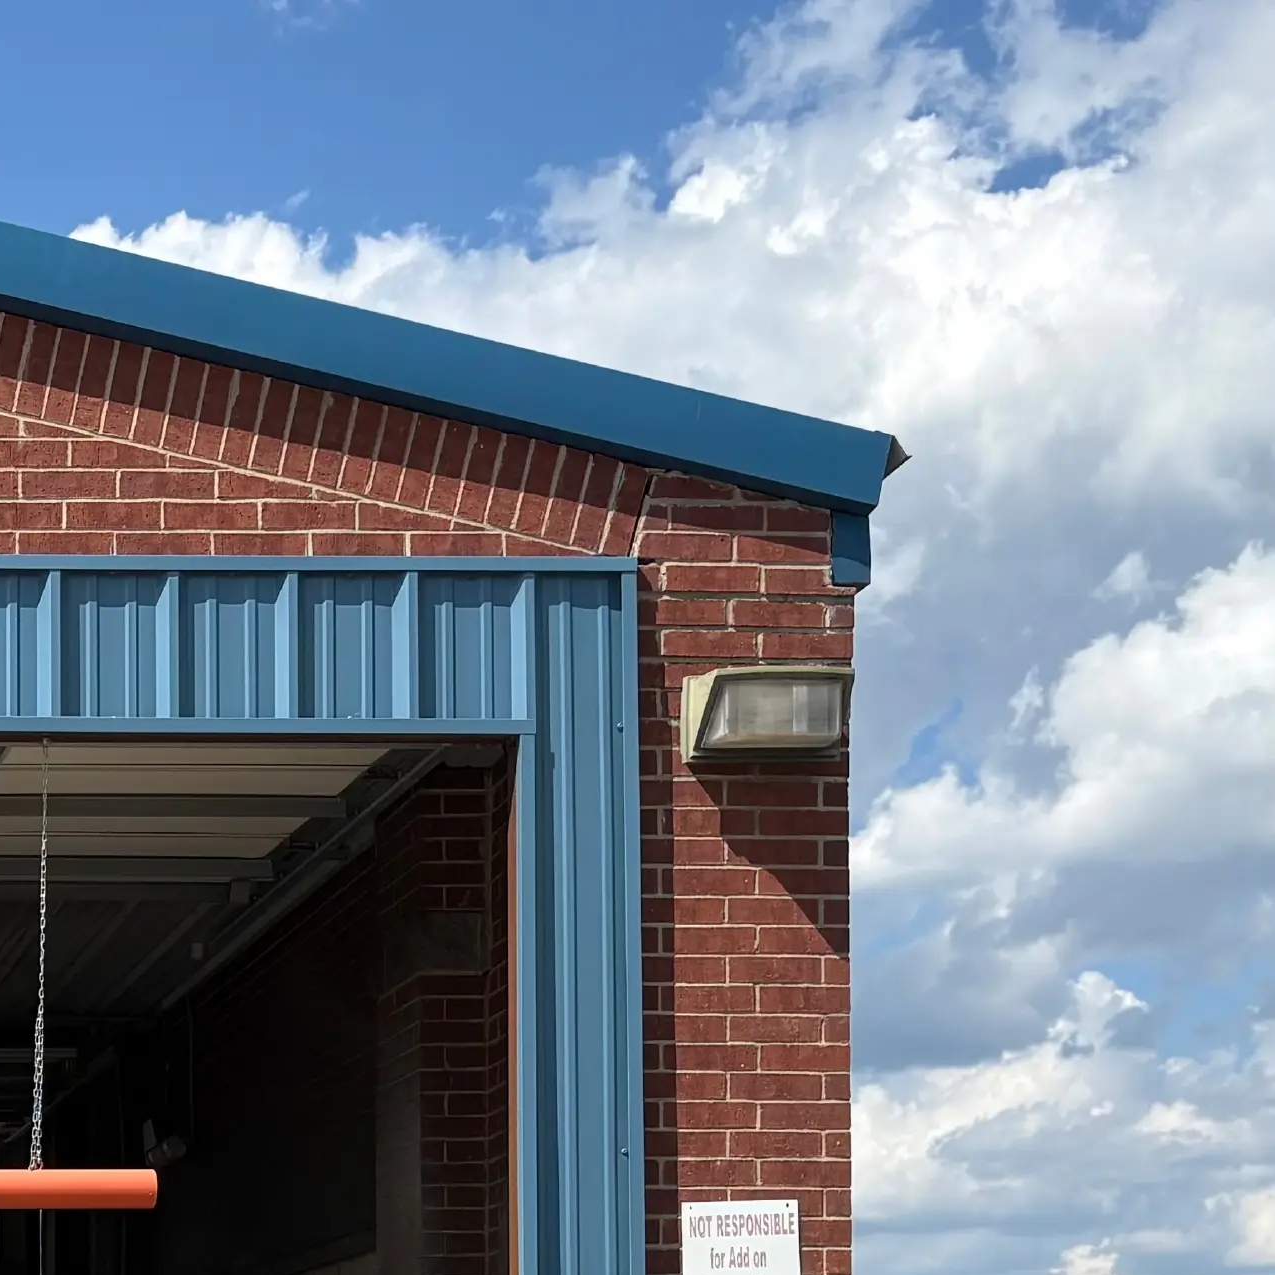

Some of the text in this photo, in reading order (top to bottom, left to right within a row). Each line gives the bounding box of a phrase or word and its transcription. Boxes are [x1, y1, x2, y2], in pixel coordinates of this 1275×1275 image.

[689, 1213, 795, 1238] NOT RESPONSIBLE
[710, 1247, 767, 1269] for Add on
